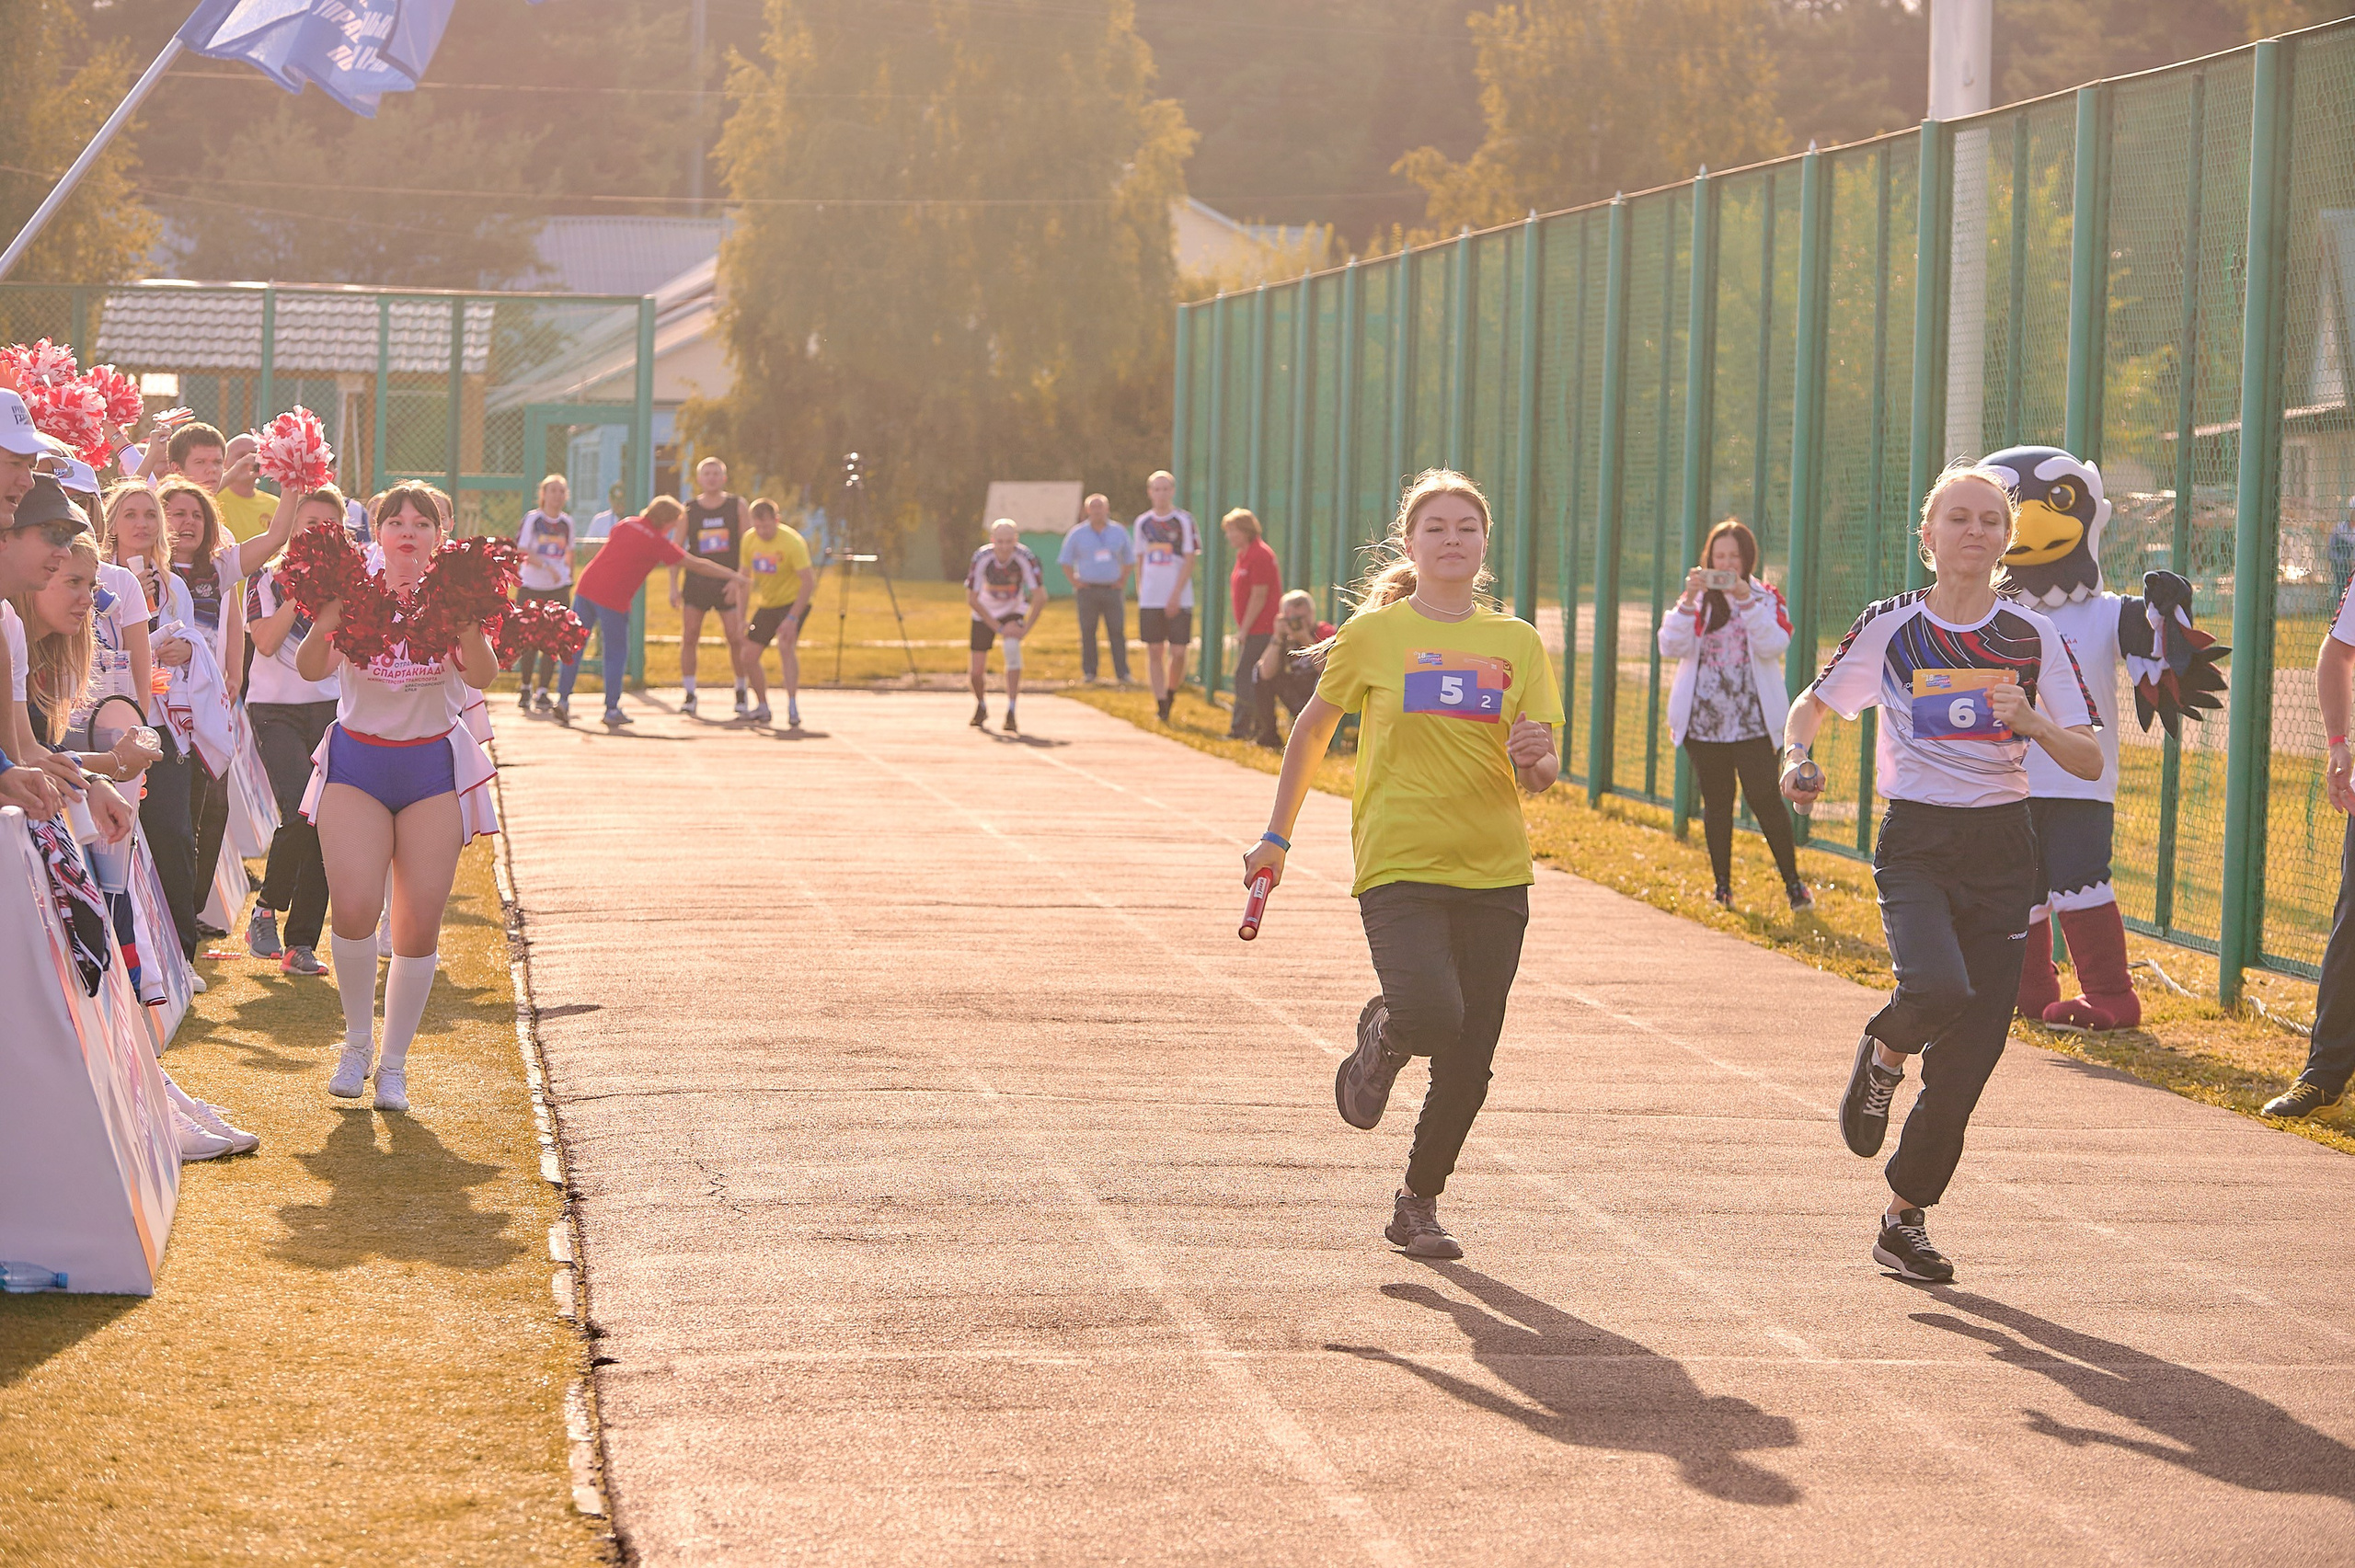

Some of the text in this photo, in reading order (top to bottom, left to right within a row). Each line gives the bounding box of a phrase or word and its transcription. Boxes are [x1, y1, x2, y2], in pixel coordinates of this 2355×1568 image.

[373, 667, 445, 678] СПАРТАКИАДА
[1440, 675, 1464, 705] 5
[1481, 695, 1492, 709] 2
[1948, 698, 1976, 728] 6
